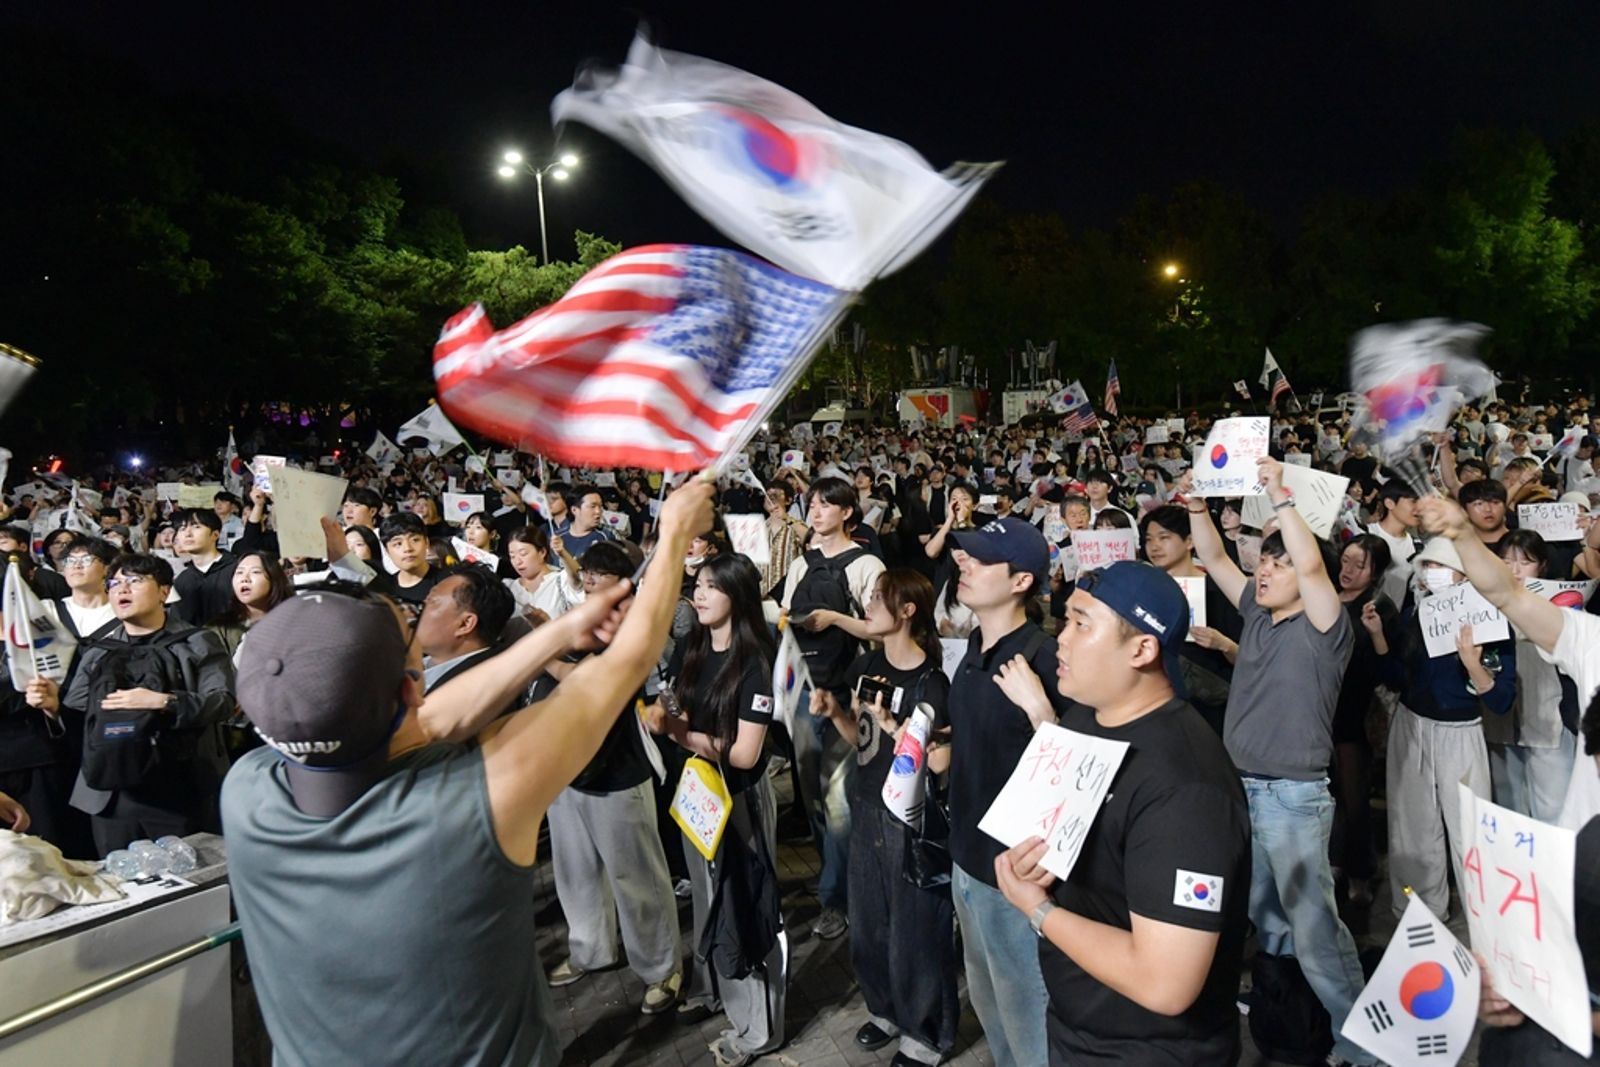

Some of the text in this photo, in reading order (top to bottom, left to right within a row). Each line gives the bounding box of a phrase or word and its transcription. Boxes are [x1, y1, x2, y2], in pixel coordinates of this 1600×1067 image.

[1520, 505, 1577, 523] 부정선거
[1425, 588, 1465, 615] Stop!
[1429, 616, 1452, 638] the
[1026, 737, 1111, 801] 부정 선거
[1056, 814, 1088, 868] 선거
[1480, 812, 1535, 859] 선거
